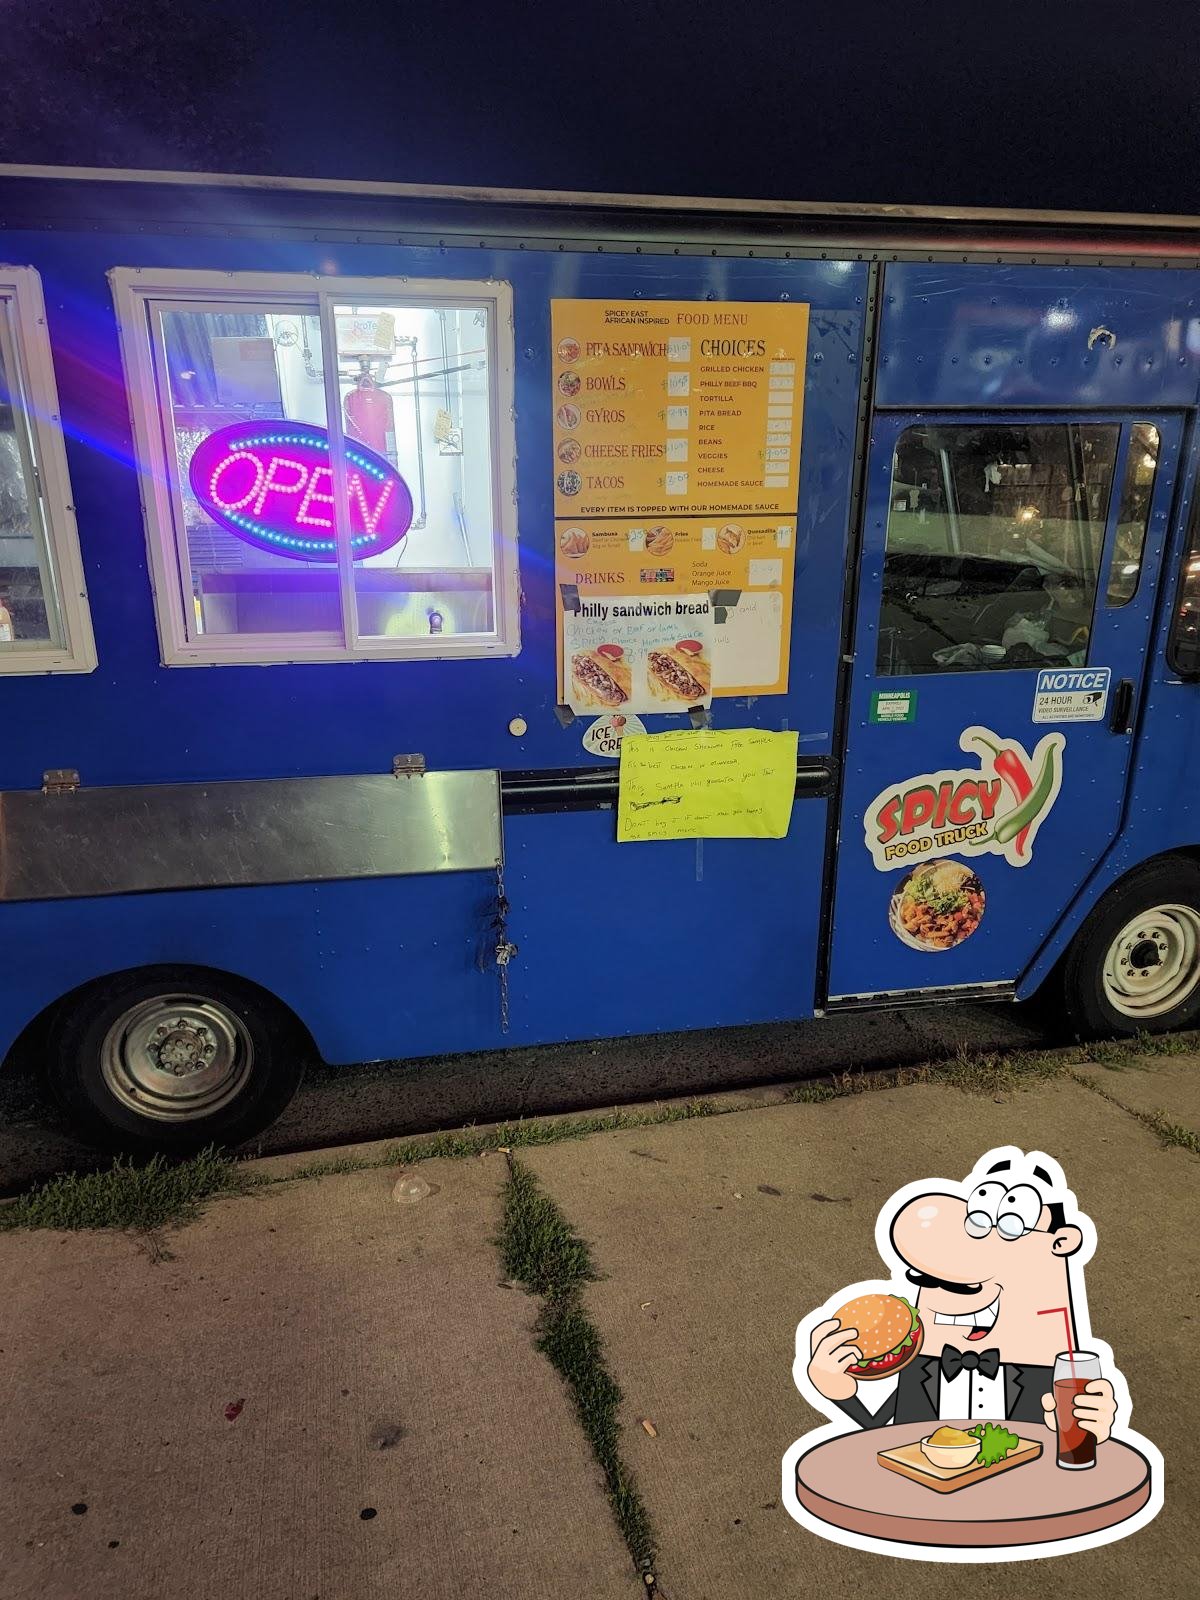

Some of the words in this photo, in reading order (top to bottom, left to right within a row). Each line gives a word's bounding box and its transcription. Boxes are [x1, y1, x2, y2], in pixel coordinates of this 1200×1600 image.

[604, 317, 636, 325] AFRICAN
[636, 317, 670, 325] INSPIRED
[677, 313, 710, 325] FOOD
[713, 313, 749, 326] MENU
[586, 342, 610, 356] PITA
[612, 341, 667, 357] SANDWICH
[700, 339, 766, 357] CHOICES
[585, 375, 626, 391] BOWLS
[699, 394, 734, 402] TORTILLA
[585, 407, 626, 423] GYROS
[584, 444, 629, 458] CHEESE
[631, 444, 663, 458] FRIES
[585, 475, 625, 489] TACOS
[209, 450, 394, 535] OPEN
[575, 571, 625, 584] DRINKS
[612, 602, 671, 617] sandwich
[675, 600, 709, 615] bread
[1040, 672, 1107, 690] NOTICE
[878, 691, 911, 700] MINNEAPOLIS
[1039, 697, 1049, 706] 24
[1051, 696, 1073, 705] HOUR
[591, 726, 611, 741] ICE
[599, 737, 623, 752] CRE
[876, 778, 1002, 844] SPICY
[884, 836, 933, 861] FOOD
[933, 822, 988, 848] TRUCK
